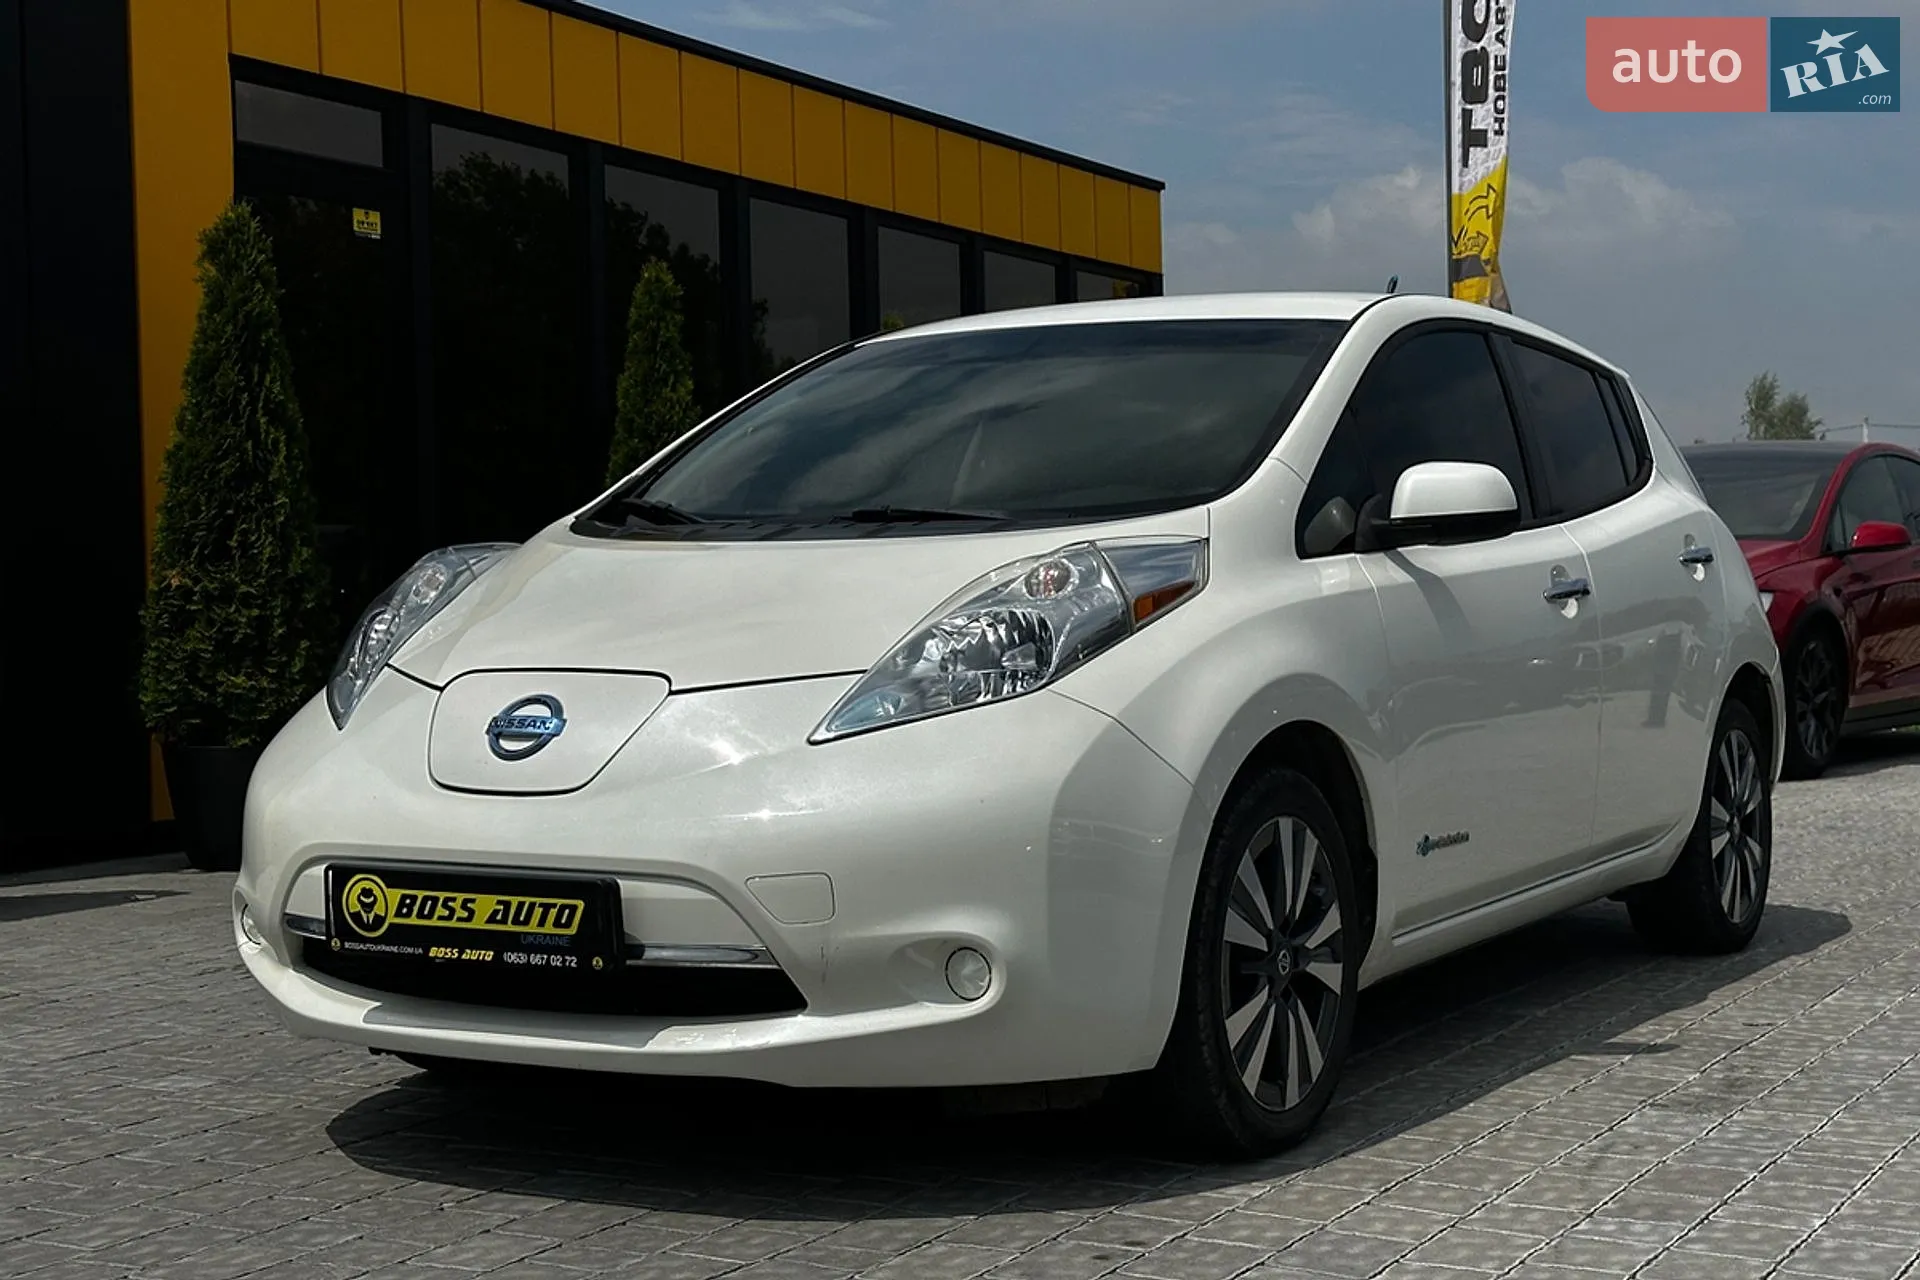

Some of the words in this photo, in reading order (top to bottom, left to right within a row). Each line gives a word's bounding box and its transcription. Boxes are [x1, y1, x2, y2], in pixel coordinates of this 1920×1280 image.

[1493, 54, 1507, 137] НОВЕ
[490, 717, 552, 731] NISSAN
[393, 892, 477, 923] BOSS
[484, 898, 580, 930] AUTO
[520, 934, 572, 947] UKRAINE
[428, 946, 459, 959] BOSS
[461, 948, 494, 961] AUTO
[503, 952, 528, 964] (063)
[530, 953, 548, 965] 667
[550, 955, 563, 967] 02
[565, 956, 578, 968] 72
